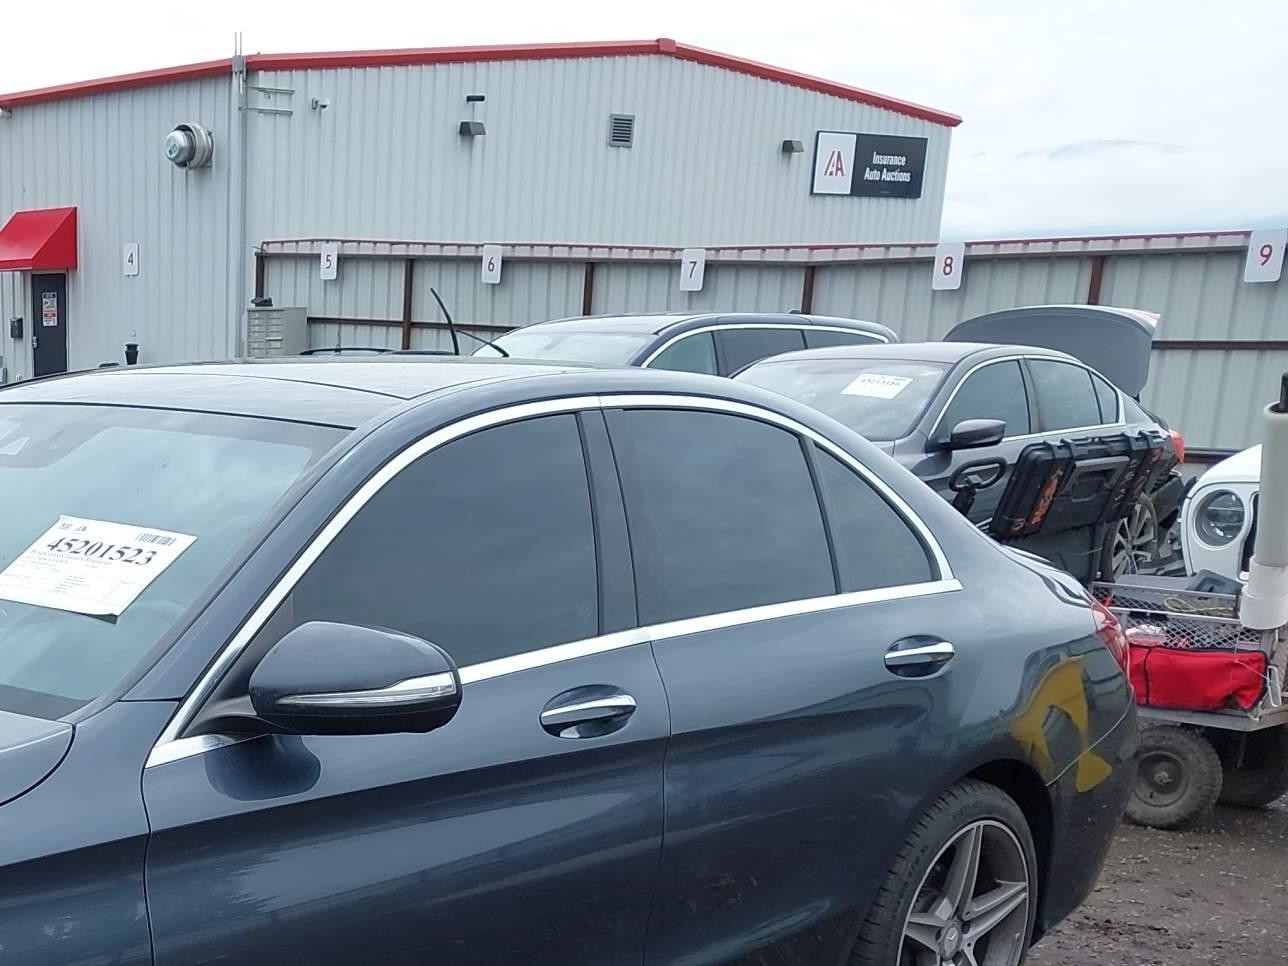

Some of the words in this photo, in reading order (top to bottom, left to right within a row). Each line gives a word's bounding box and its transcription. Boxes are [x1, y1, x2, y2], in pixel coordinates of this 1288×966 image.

[872, 151, 906, 166] Insurance
[863, 167, 881, 181] Auto
[881, 167, 911, 182] Auctions
[127, 251, 134, 266] 4
[325, 254, 332, 269] 5
[1260, 244, 1273, 266] 9
[487, 256, 495, 272] 6
[689, 261, 697, 279] 7
[943, 256, 953, 276] 8
[47, 537, 157, 565] 45201523
